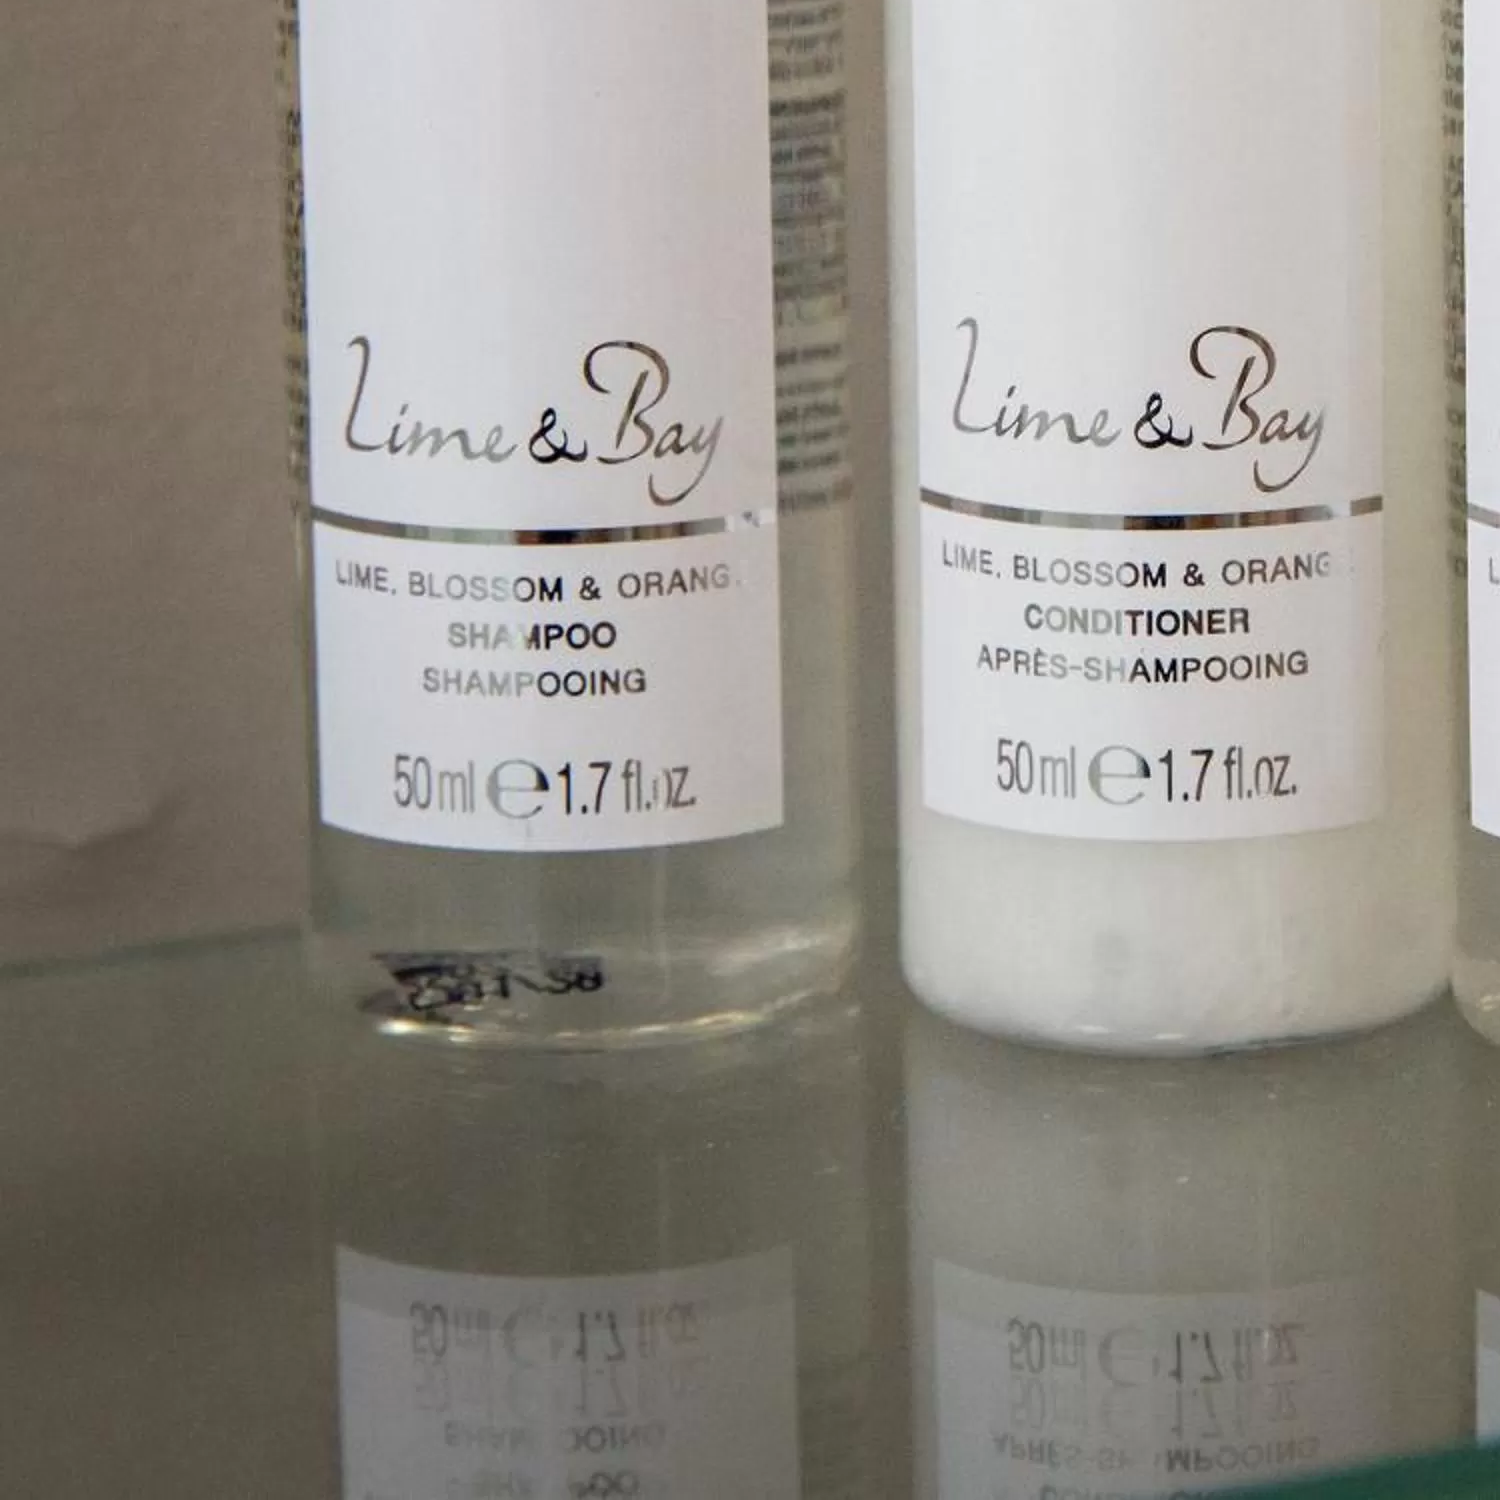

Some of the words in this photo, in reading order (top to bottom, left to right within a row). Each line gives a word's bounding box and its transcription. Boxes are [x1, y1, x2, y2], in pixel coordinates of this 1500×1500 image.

[345, 336, 518, 463] Lime
[528, 407, 588, 463] &
[583, 340, 724, 506] Bay
[953, 317, 1121, 448] Lime
[1134, 392, 1193, 448] &
[1189, 326, 1327, 492] Bay
[408, 570, 563, 602] BLOSSOM
[579, 577, 601, 600] &
[617, 564, 739, 598] ORANG
[1013, 553, 1167, 588] BLOSSOM
[1183, 565, 1206, 587] &
[1222, 551, 1333, 584] ORANG
[1024, 603, 1251, 636] CONDITIONER
[423, 667, 646, 697] SHAMPOOING
[977, 644, 1309, 684] APRÈS-SHAMPOOING
